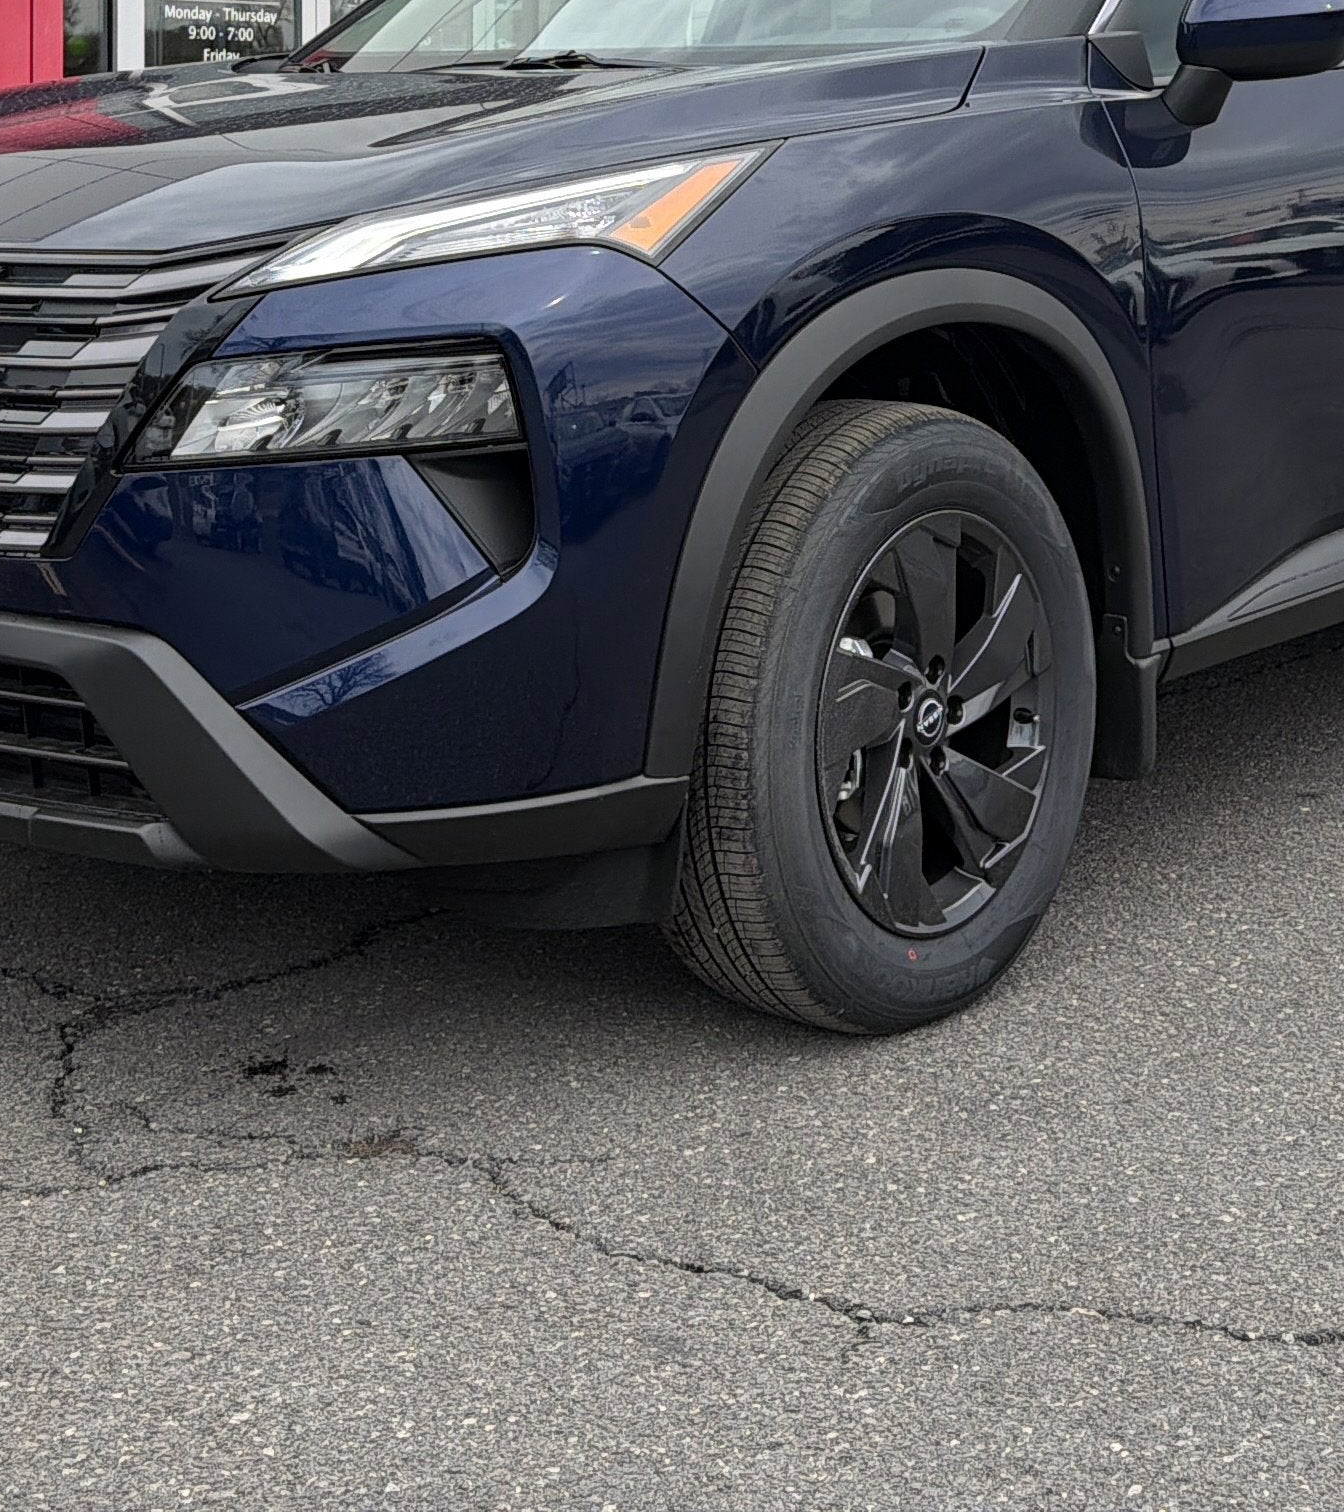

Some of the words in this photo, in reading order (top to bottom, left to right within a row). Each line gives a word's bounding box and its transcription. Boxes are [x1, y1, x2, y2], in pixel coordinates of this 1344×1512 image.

[164, 4, 213, 23] Monday
[223, 7, 278, 24] Thursday
[188, 26, 216, 40] 9:00
[227, 28, 254, 41] 7:00
[203, 48, 240, 62] Friday
